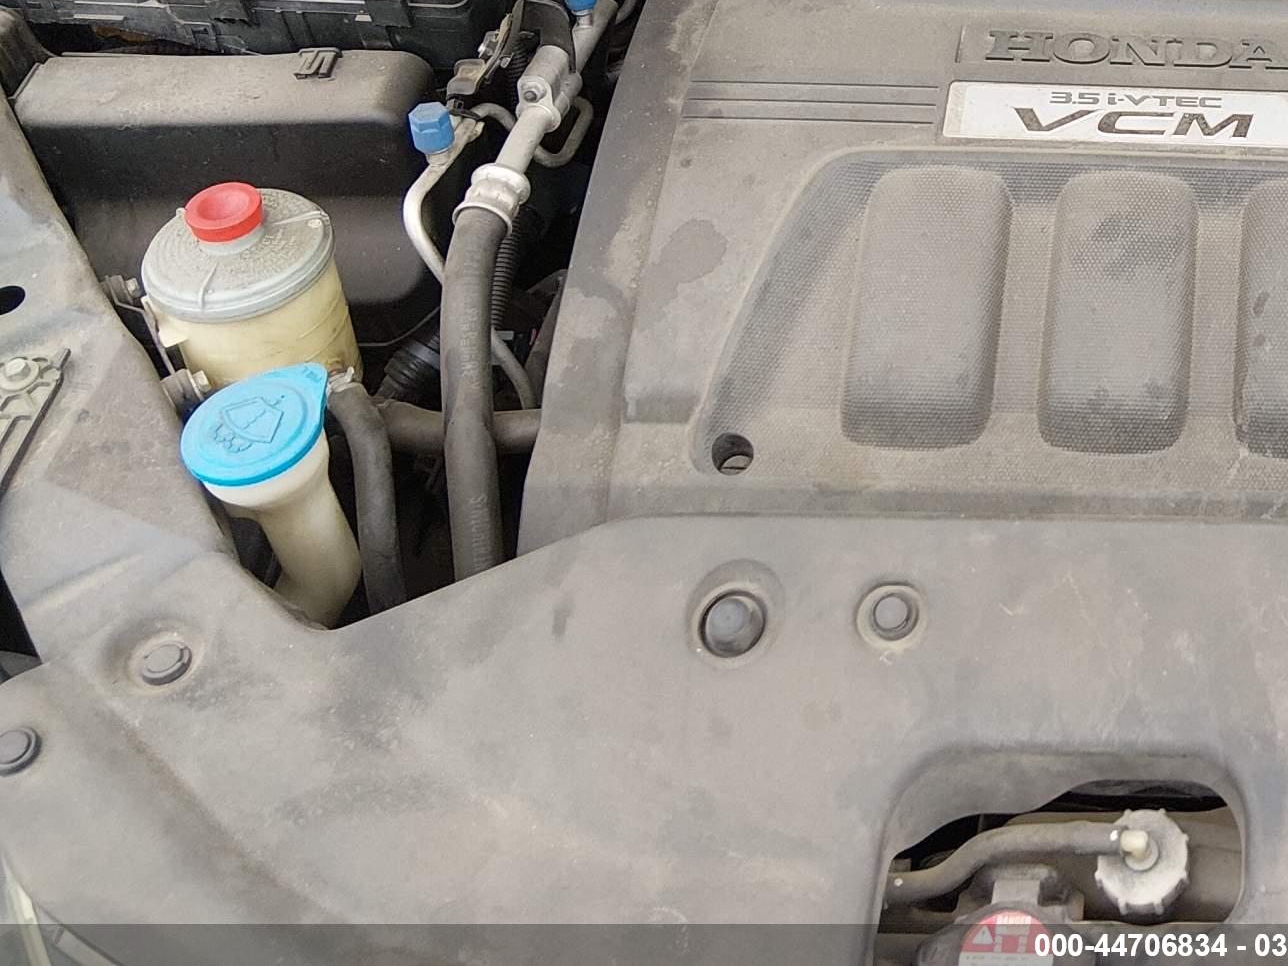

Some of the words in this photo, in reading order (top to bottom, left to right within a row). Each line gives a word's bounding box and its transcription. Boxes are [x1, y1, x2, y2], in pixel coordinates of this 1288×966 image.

[1049, 91, 1099, 106] 3.5
[1107, 92, 1222, 108] i-VTEC
[1013, 107, 1255, 138] VCM
